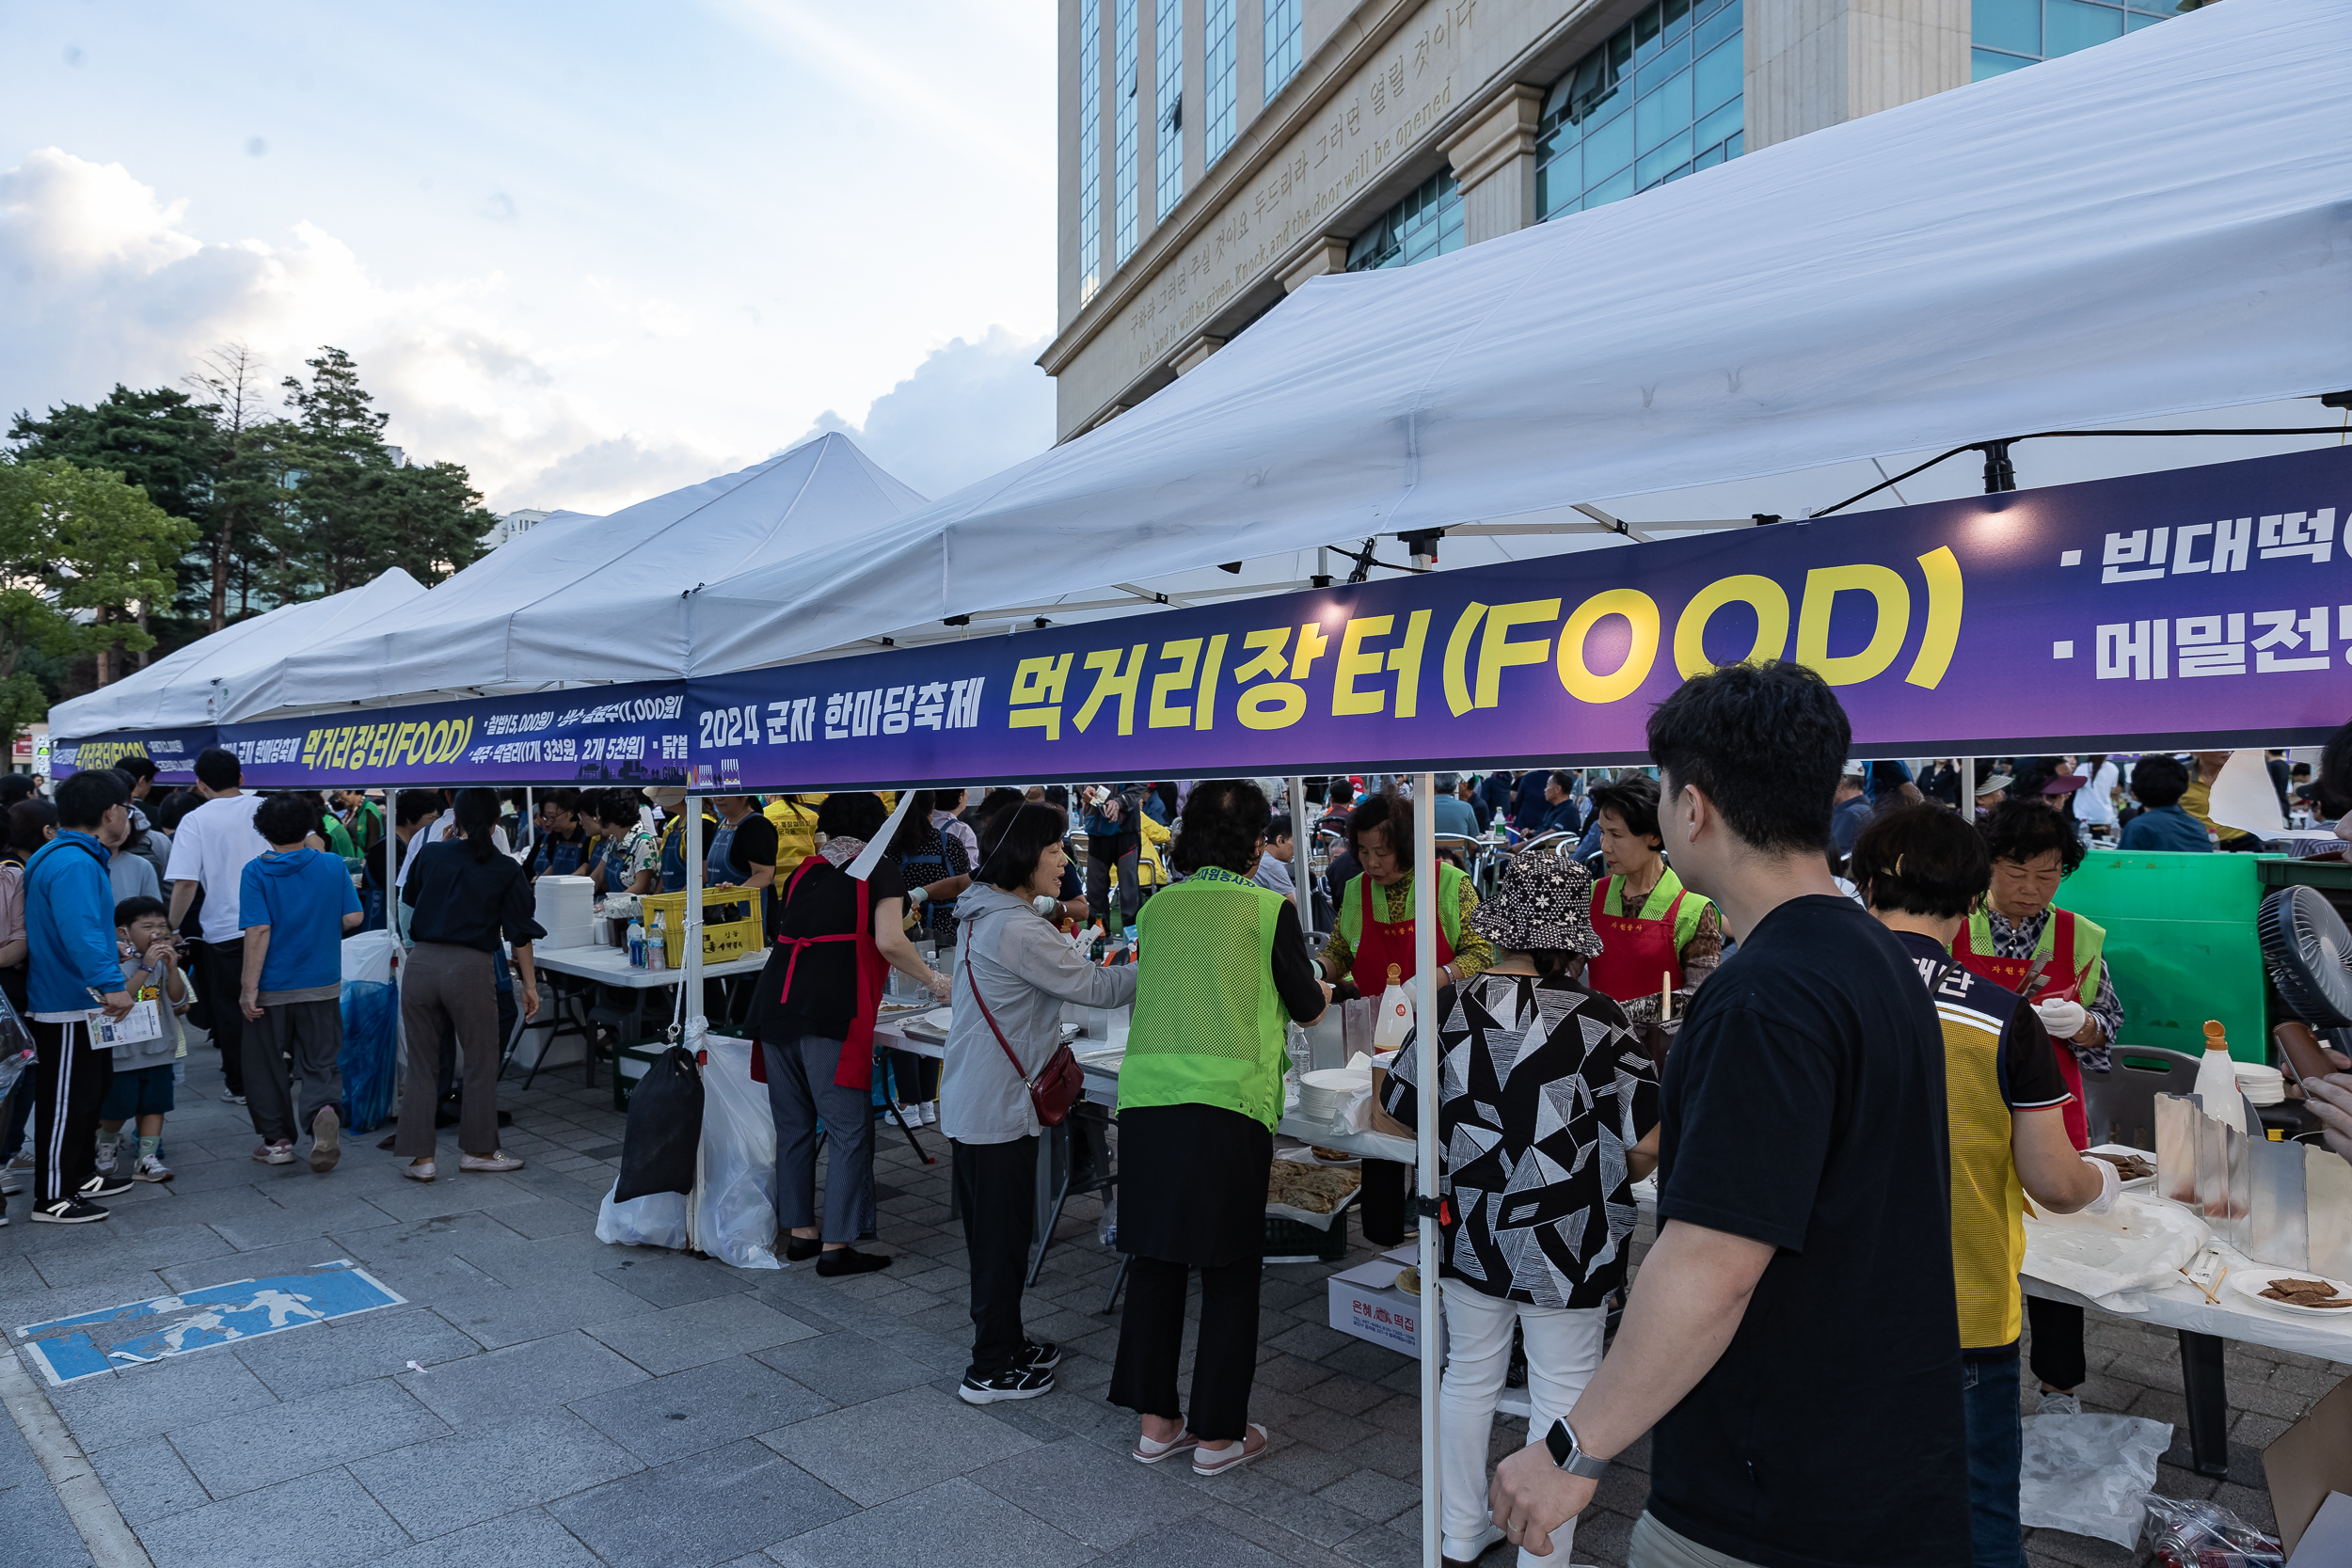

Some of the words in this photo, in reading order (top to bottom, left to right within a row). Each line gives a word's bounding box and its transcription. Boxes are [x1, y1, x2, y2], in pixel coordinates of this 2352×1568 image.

[1130, 296, 1155, 340] 구하라
[1158, 266, 1186, 314] 그러면
[1189, 243, 1211, 284] 주실
[1215, 211, 1249, 264] 것이요
[1253, 150, 1309, 224] 두드리라
[1314, 98, 1361, 169] 그러면
[1370, 55, 1405, 117] 열릴
[1413, 0, 1477, 81] 것이다
[1179, 307, 1195, 333] will
[1195, 298, 1205, 320] be
[1234, 244, 1270, 286] Knock,
[1270, 220, 1290, 256] and
[1292, 207, 1311, 236] the
[1313, 180, 1343, 216] door
[1343, 149, 1370, 191] will
[1374, 137, 1391, 166] be
[1395, 76, 1452, 148] opened
[1009, 545, 1964, 741] 먹거리장터(FOOD)
[2095, 605, 2352, 681] 메밀전
[301, 716, 474, 770] 먹거리장터(FOOD)
[543, 738, 579, 763] 3천원,
[581, 737, 606, 761] 2개
[605, 736, 645, 760] 5천원)
[699, 705, 760, 750] 2024
[766, 696, 817, 745] 군자
[824, 676, 986, 740] 한마당축제
[238, 740, 256, 765] 군자
[254, 736, 302, 765] 한마당축제
[1352, 1299, 1373, 1319] 은혜
[1393, 1313, 1415, 1333] 떡집
